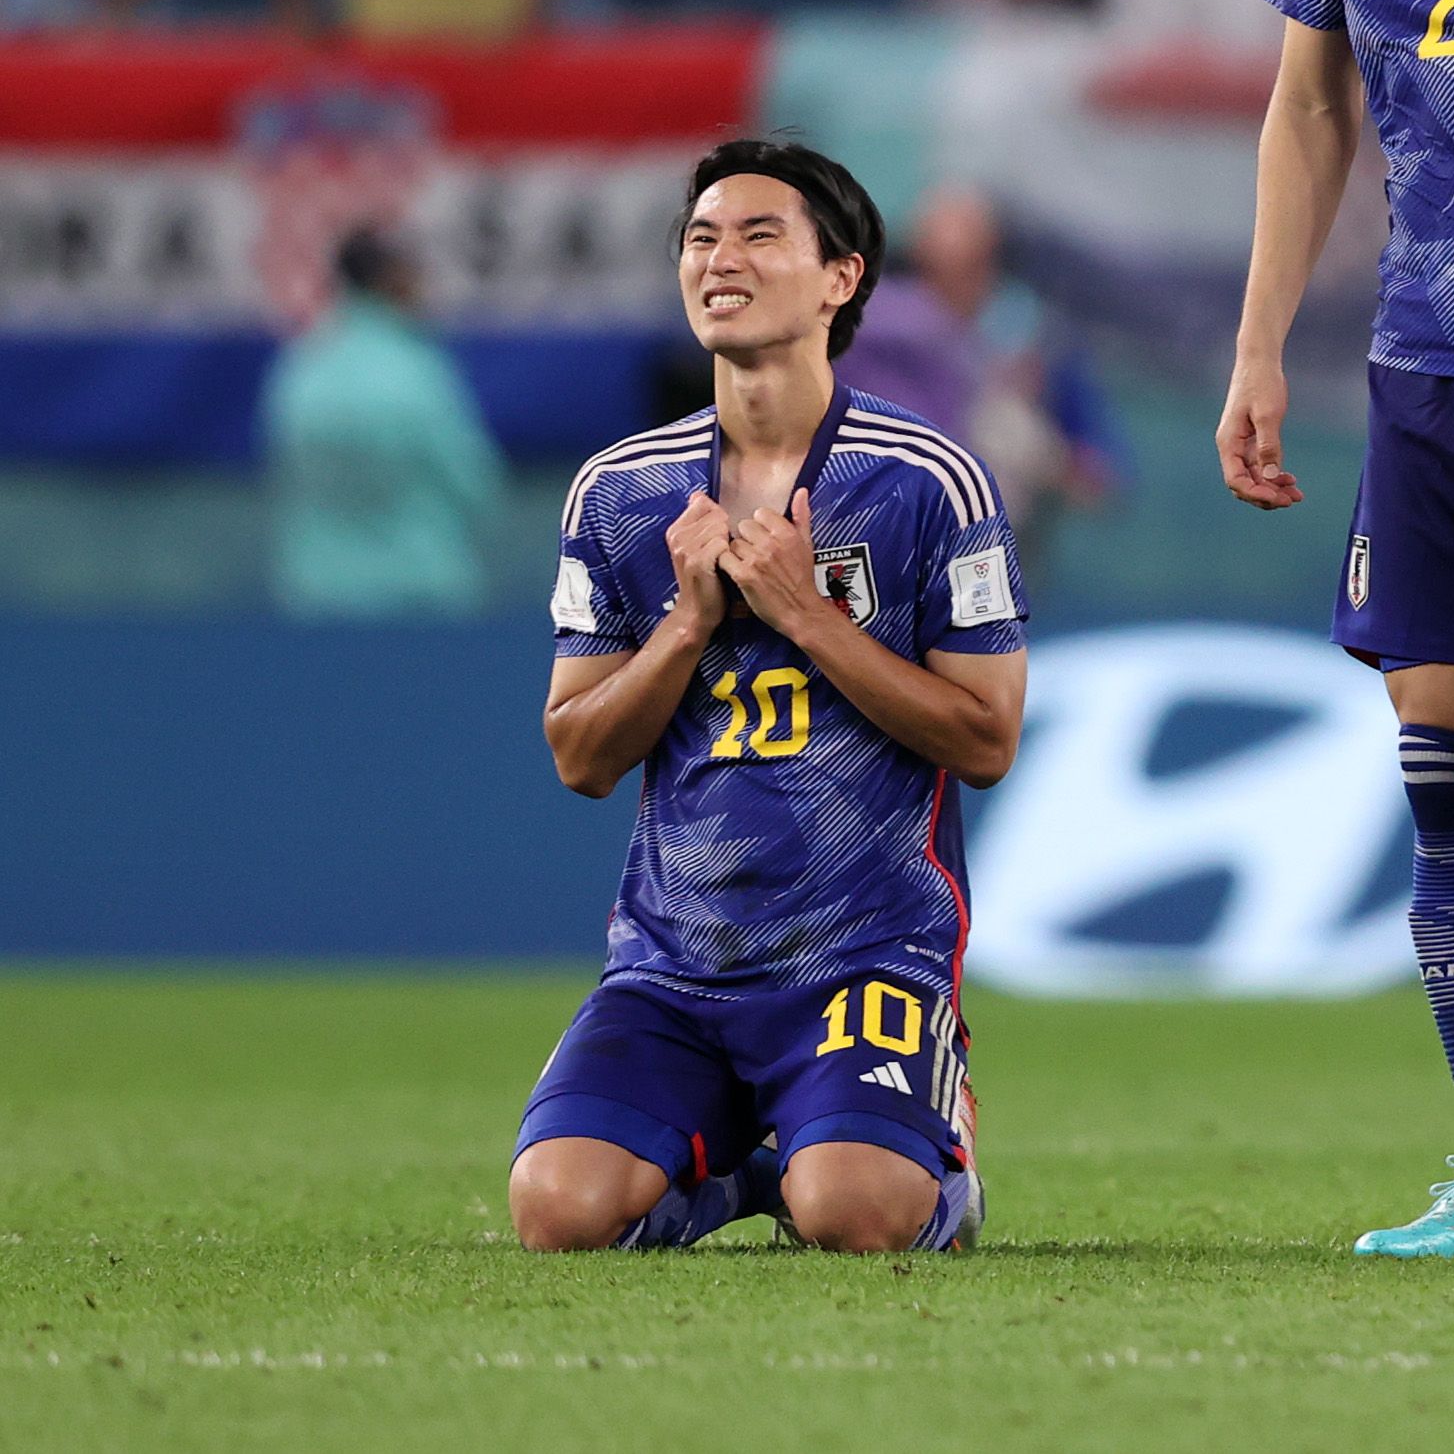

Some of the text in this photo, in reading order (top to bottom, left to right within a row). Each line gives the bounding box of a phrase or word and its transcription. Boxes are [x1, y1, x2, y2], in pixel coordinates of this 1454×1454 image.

[816, 549, 852, 562] JAPAN
[710, 666, 810, 758] 10
[817, 979, 923, 1058] 10
